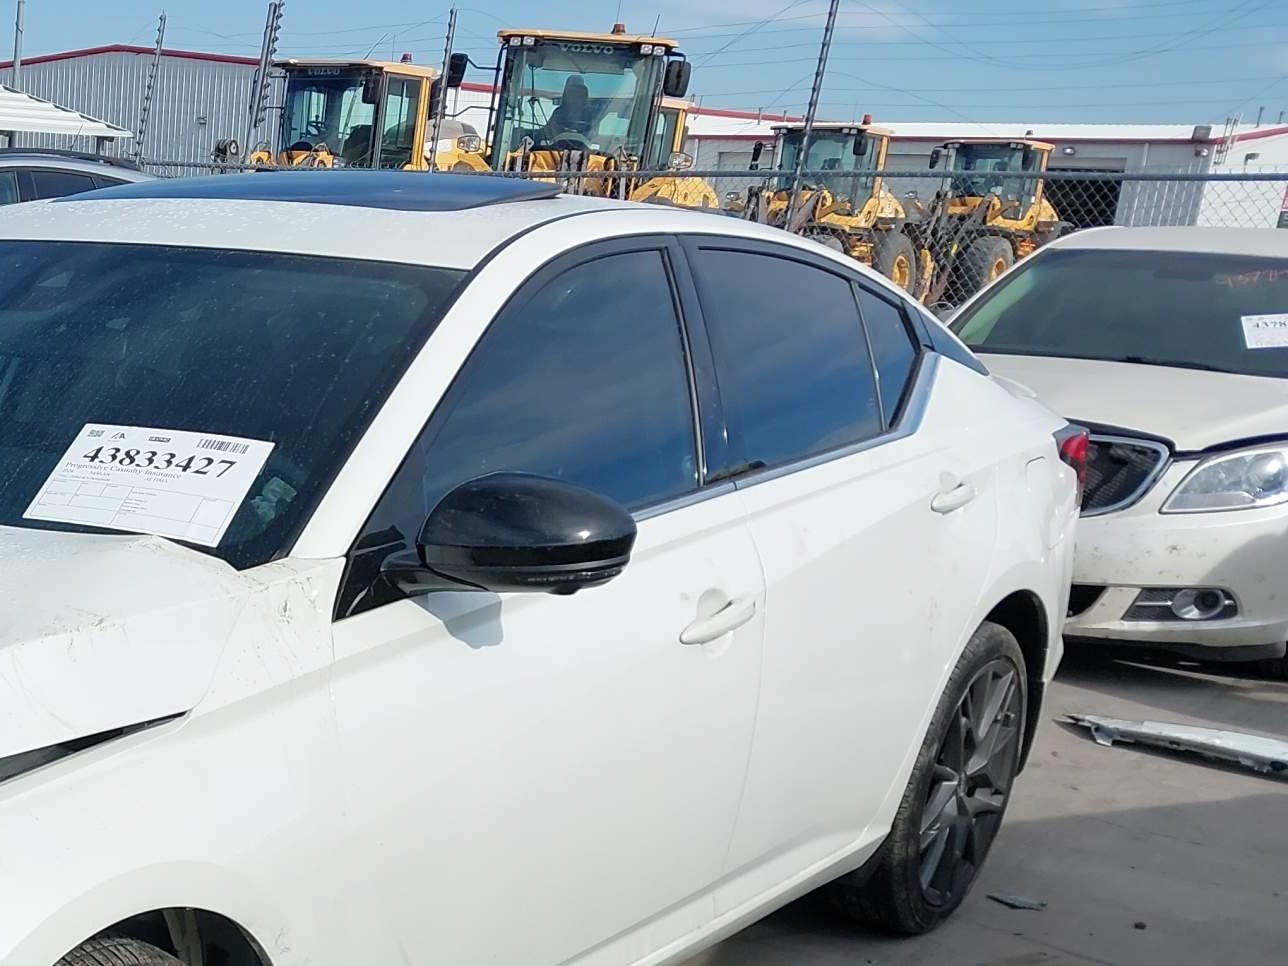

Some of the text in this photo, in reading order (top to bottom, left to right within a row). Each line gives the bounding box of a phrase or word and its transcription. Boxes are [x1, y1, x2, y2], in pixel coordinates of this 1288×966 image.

[560, 43, 614, 55] VOLVO
[307, 68, 341, 76] VOLVO
[82, 445, 238, 478] 43833427
[65, 462, 182, 480] Progressive Casualty Insurance
